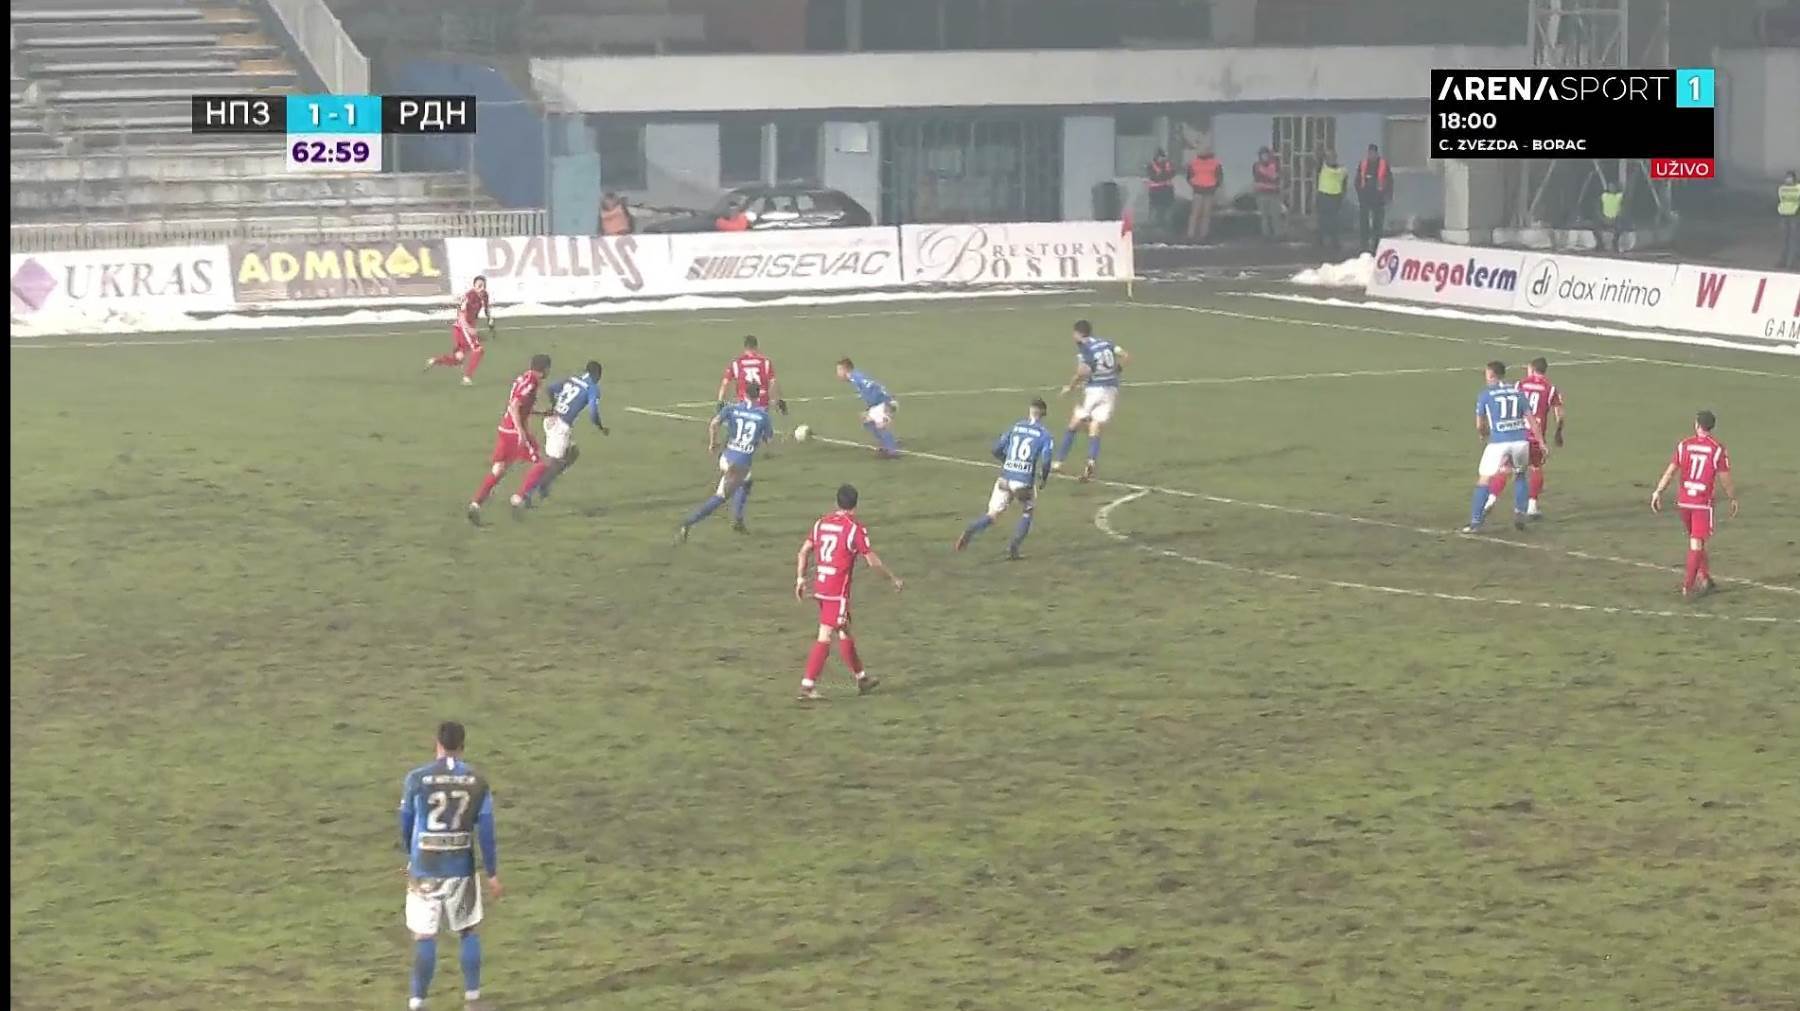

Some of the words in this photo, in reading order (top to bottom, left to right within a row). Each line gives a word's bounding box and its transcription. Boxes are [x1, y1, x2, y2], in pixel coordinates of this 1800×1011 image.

[481, 236, 645, 292] DALLAS
[916, 224, 1116, 283] Bosna
[992, 241, 1117, 258] RESTORAN
[64, 258, 214, 300] UKRAS
[1400, 258, 1518, 293] megaterm
[1600, 277, 1661, 307] intimo
[1011, 435, 1034, 461] 16
[427, 790, 471, 831] 27
